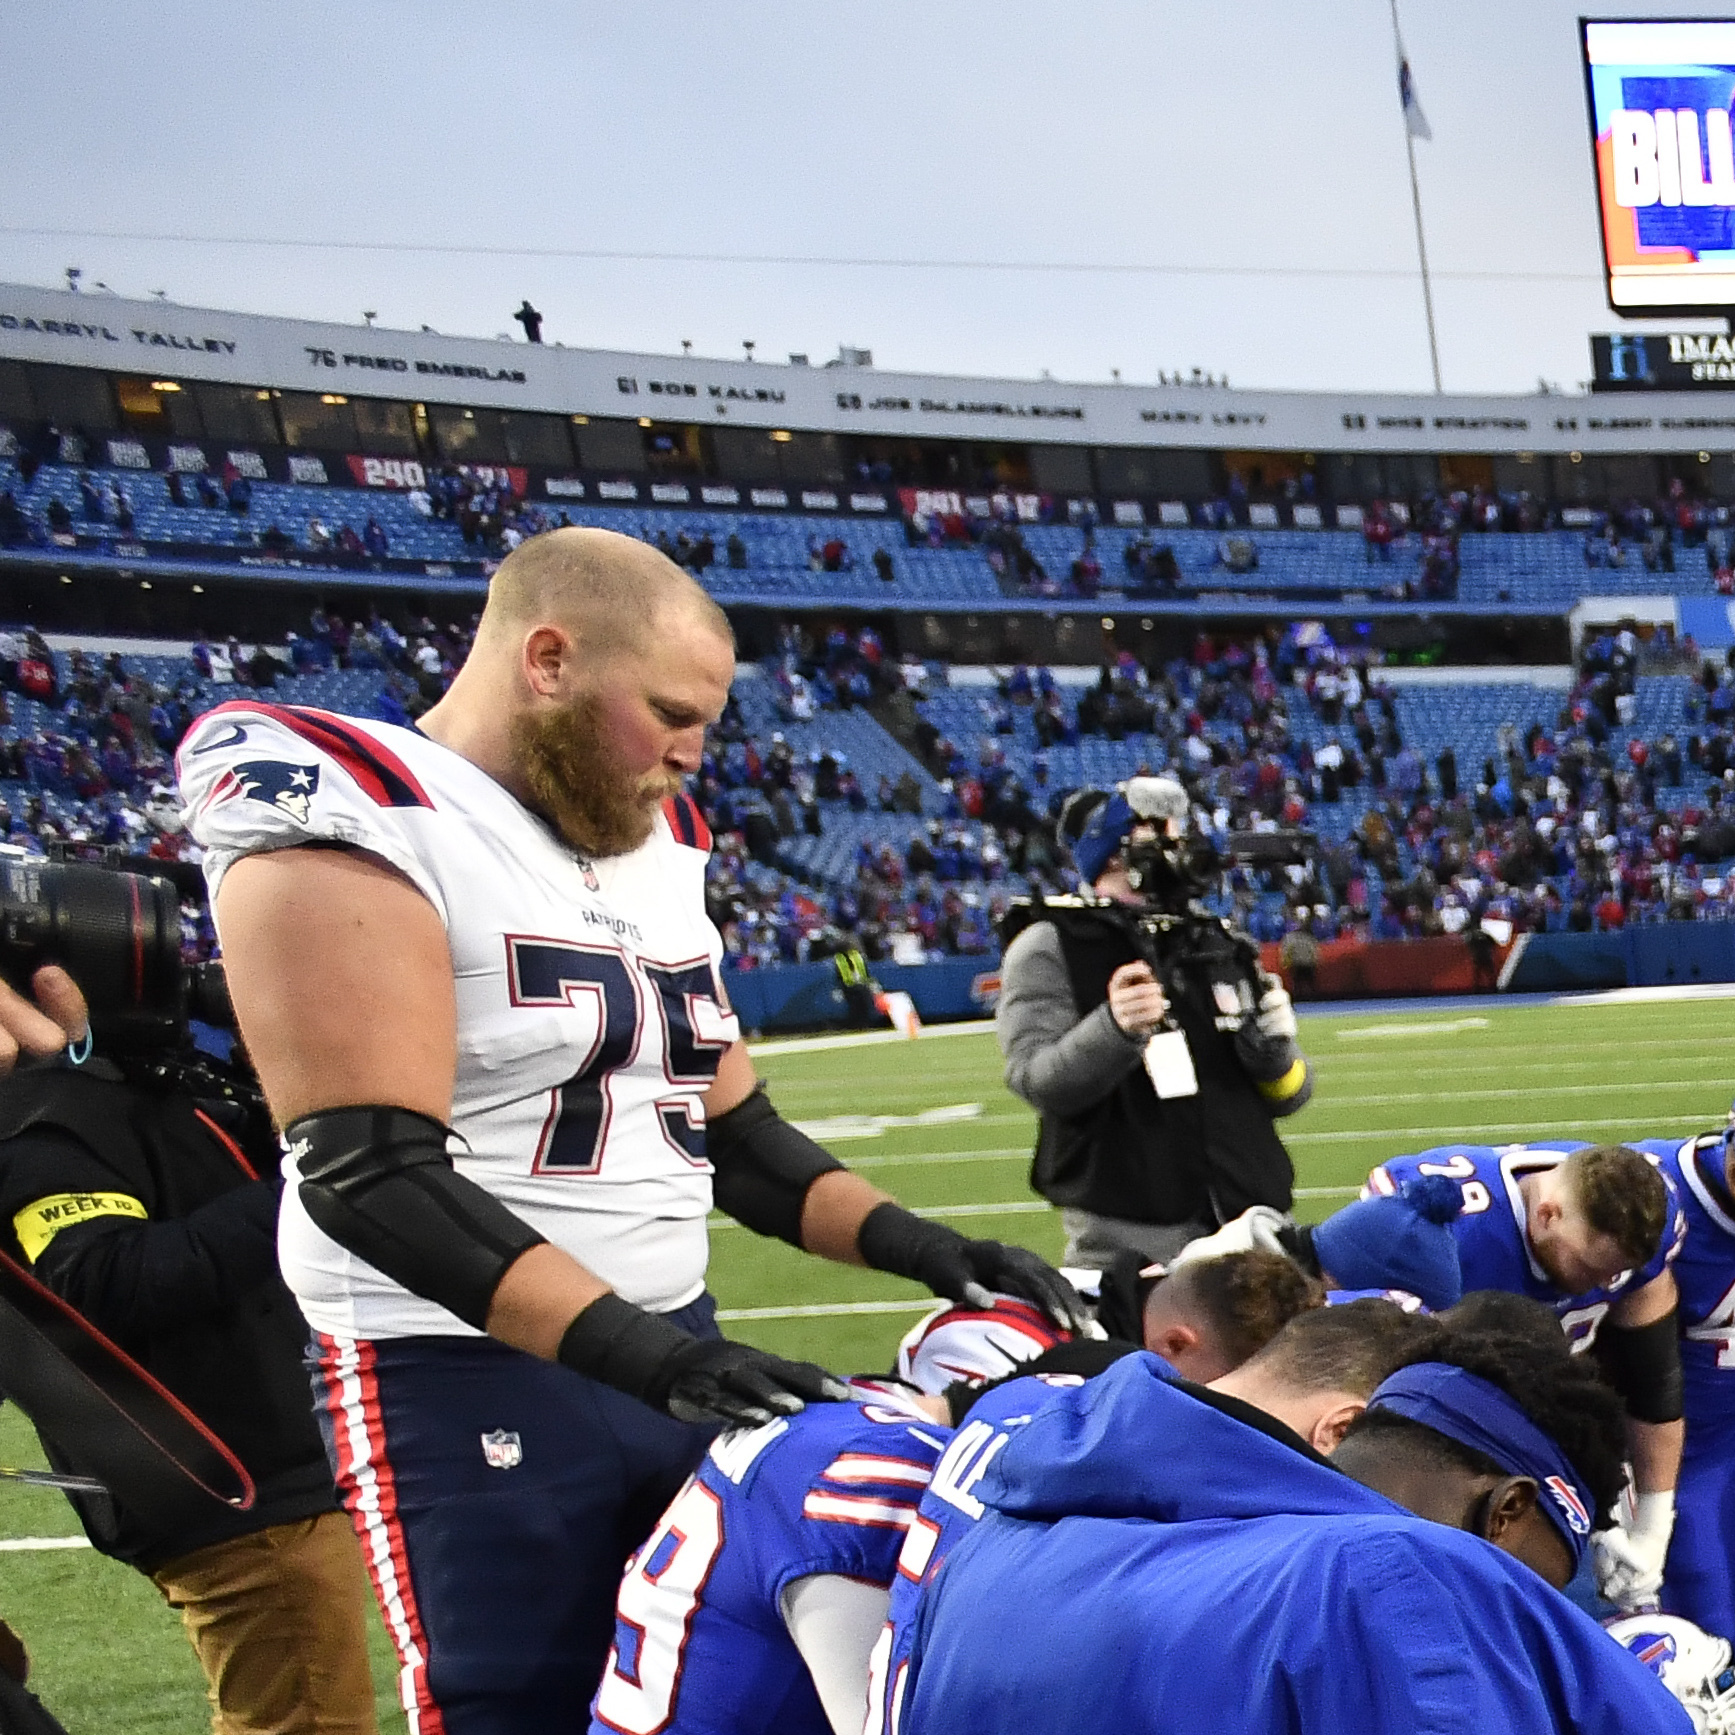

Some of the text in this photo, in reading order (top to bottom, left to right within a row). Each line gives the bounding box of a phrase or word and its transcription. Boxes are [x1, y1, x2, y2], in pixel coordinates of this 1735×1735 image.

[0, 314, 236, 354] DARRYL TALLEY
[343, 353, 408, 373] FRED
[363, 455, 426, 488] 240
[504, 933, 735, 1178] 75
[39, 1199, 106, 1224] WEEK
